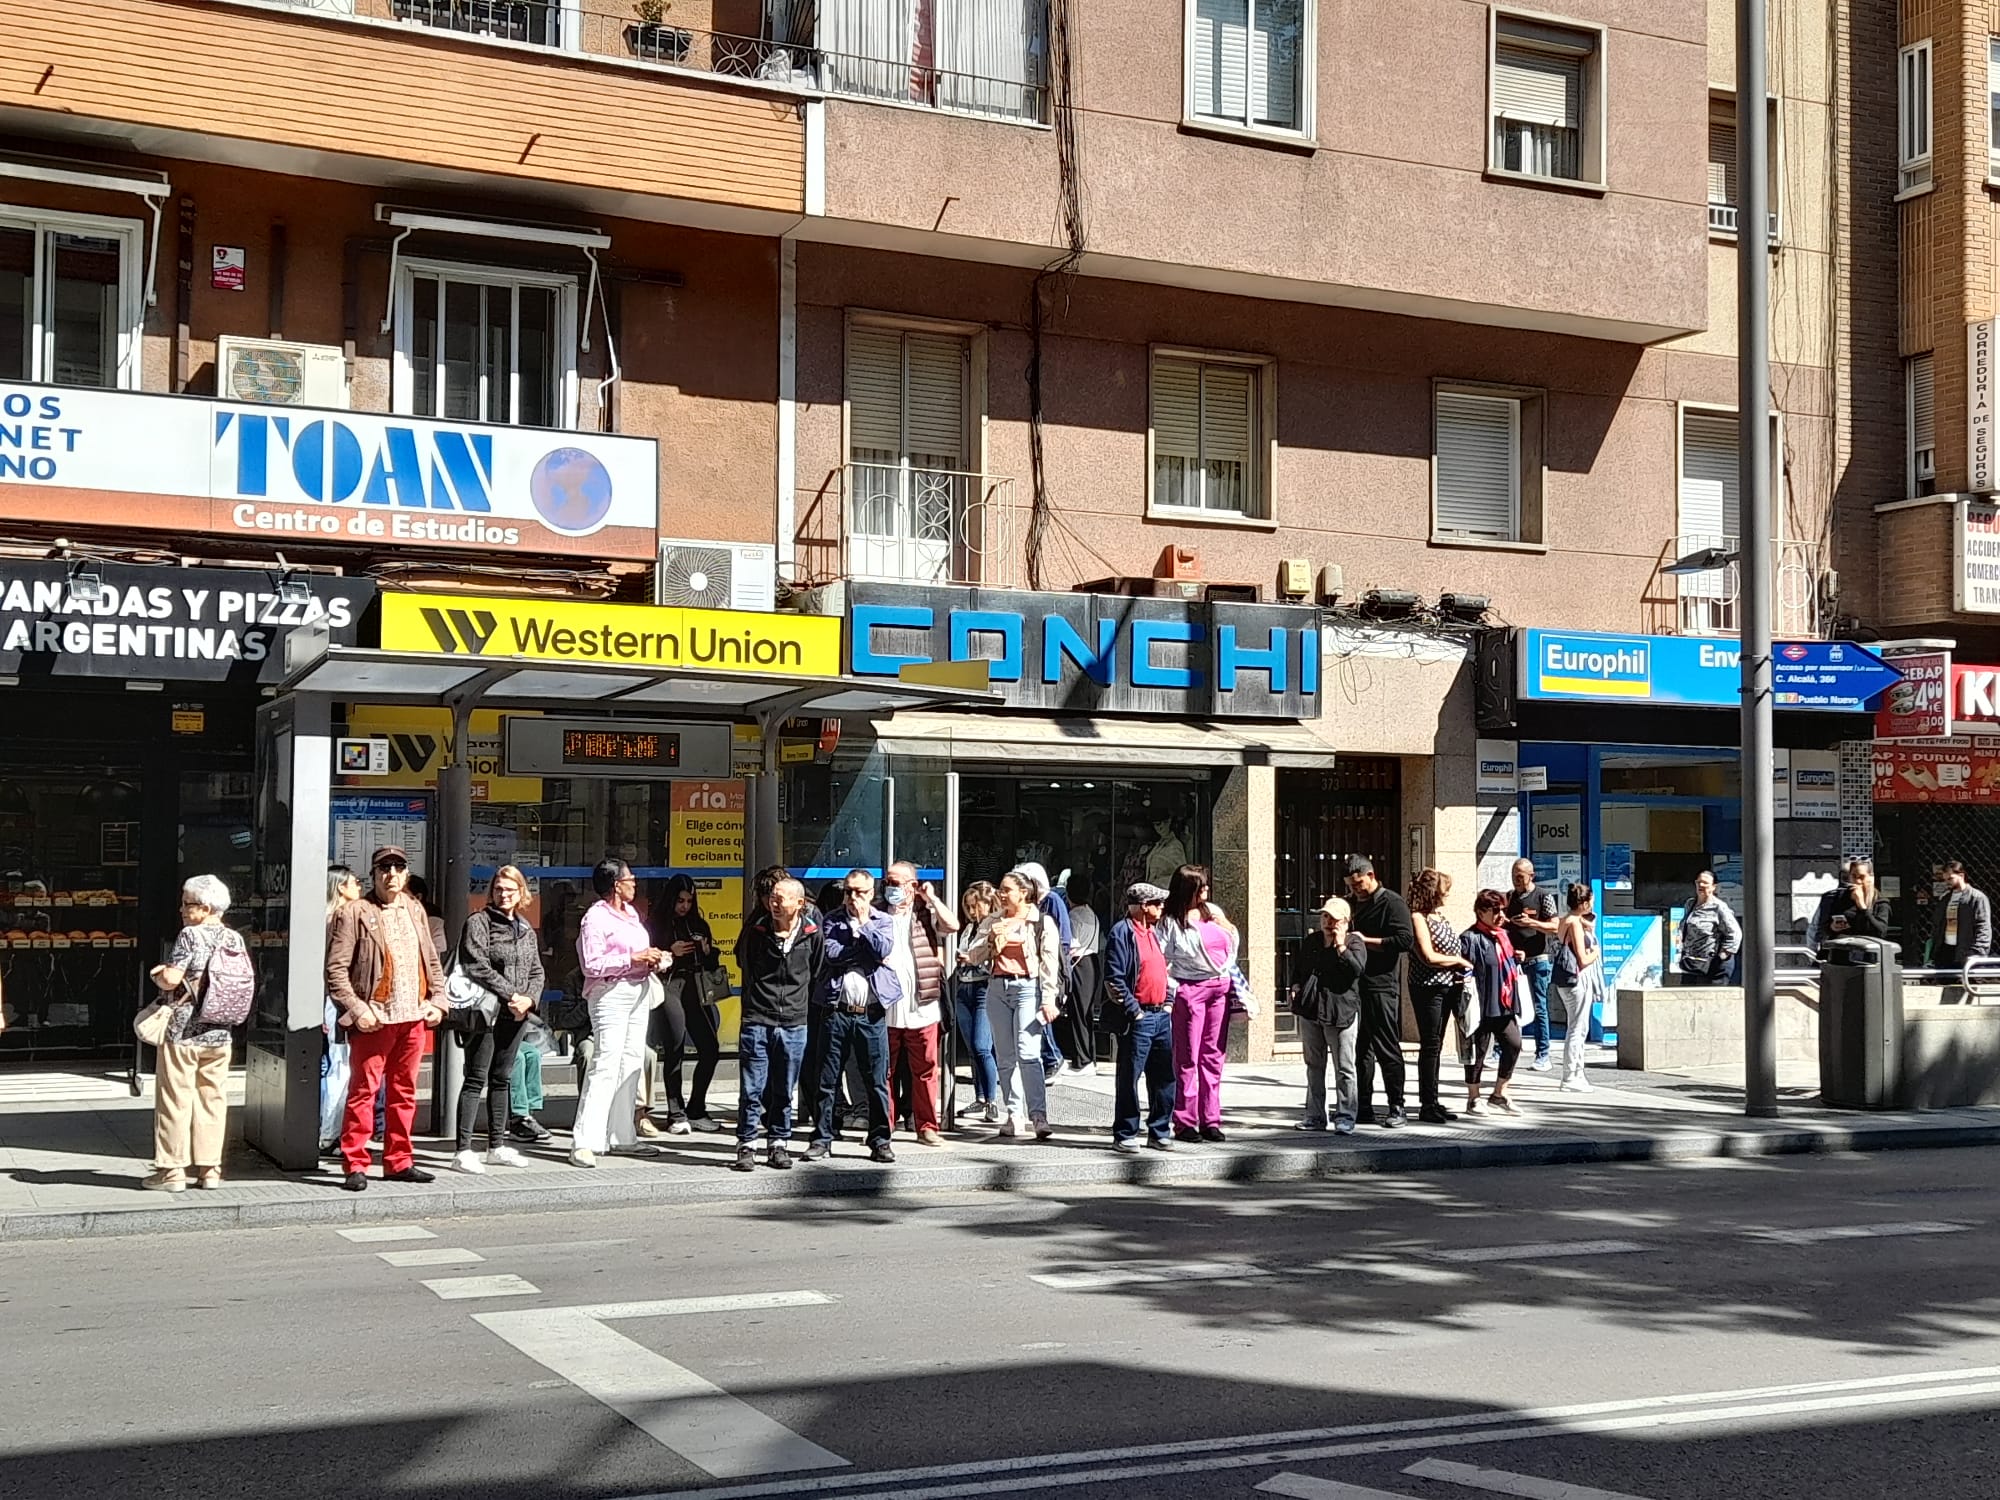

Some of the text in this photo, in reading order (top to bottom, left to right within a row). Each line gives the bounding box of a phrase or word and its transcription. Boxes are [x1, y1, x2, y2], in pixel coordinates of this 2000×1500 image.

[1976, 323, 1988, 410] CORREDURIA
[1973, 414, 1989, 425] DE
[215, 410, 493, 513] TOAN
[1976, 428, 1988, 488] SEGUROS
[232, 503, 519, 545] Centro de Estudios
[181, 588, 210, 621] Y
[218, 590, 351, 628] PIZZAS
[4, 618, 268, 662] ARGENTINAS
[509, 616, 802, 665] Western Union
[851, 604, 1318, 695] CONCHI
[1546, 643, 1646, 679] Europhil
[1775, 675, 1786, 684] C.
[1798, 695, 1829, 704] Pueblo
[1830, 695, 1859, 704] Nuevo
[1912, 753, 1971, 763] DURUM
[689, 783, 727, 809] ria
[1321, 778, 1340, 791] 373
[686, 819, 713, 833] Elige
[685, 836, 731, 848] quieres
[685, 850, 731, 862] reciban
[708, 911, 720, 920] En
